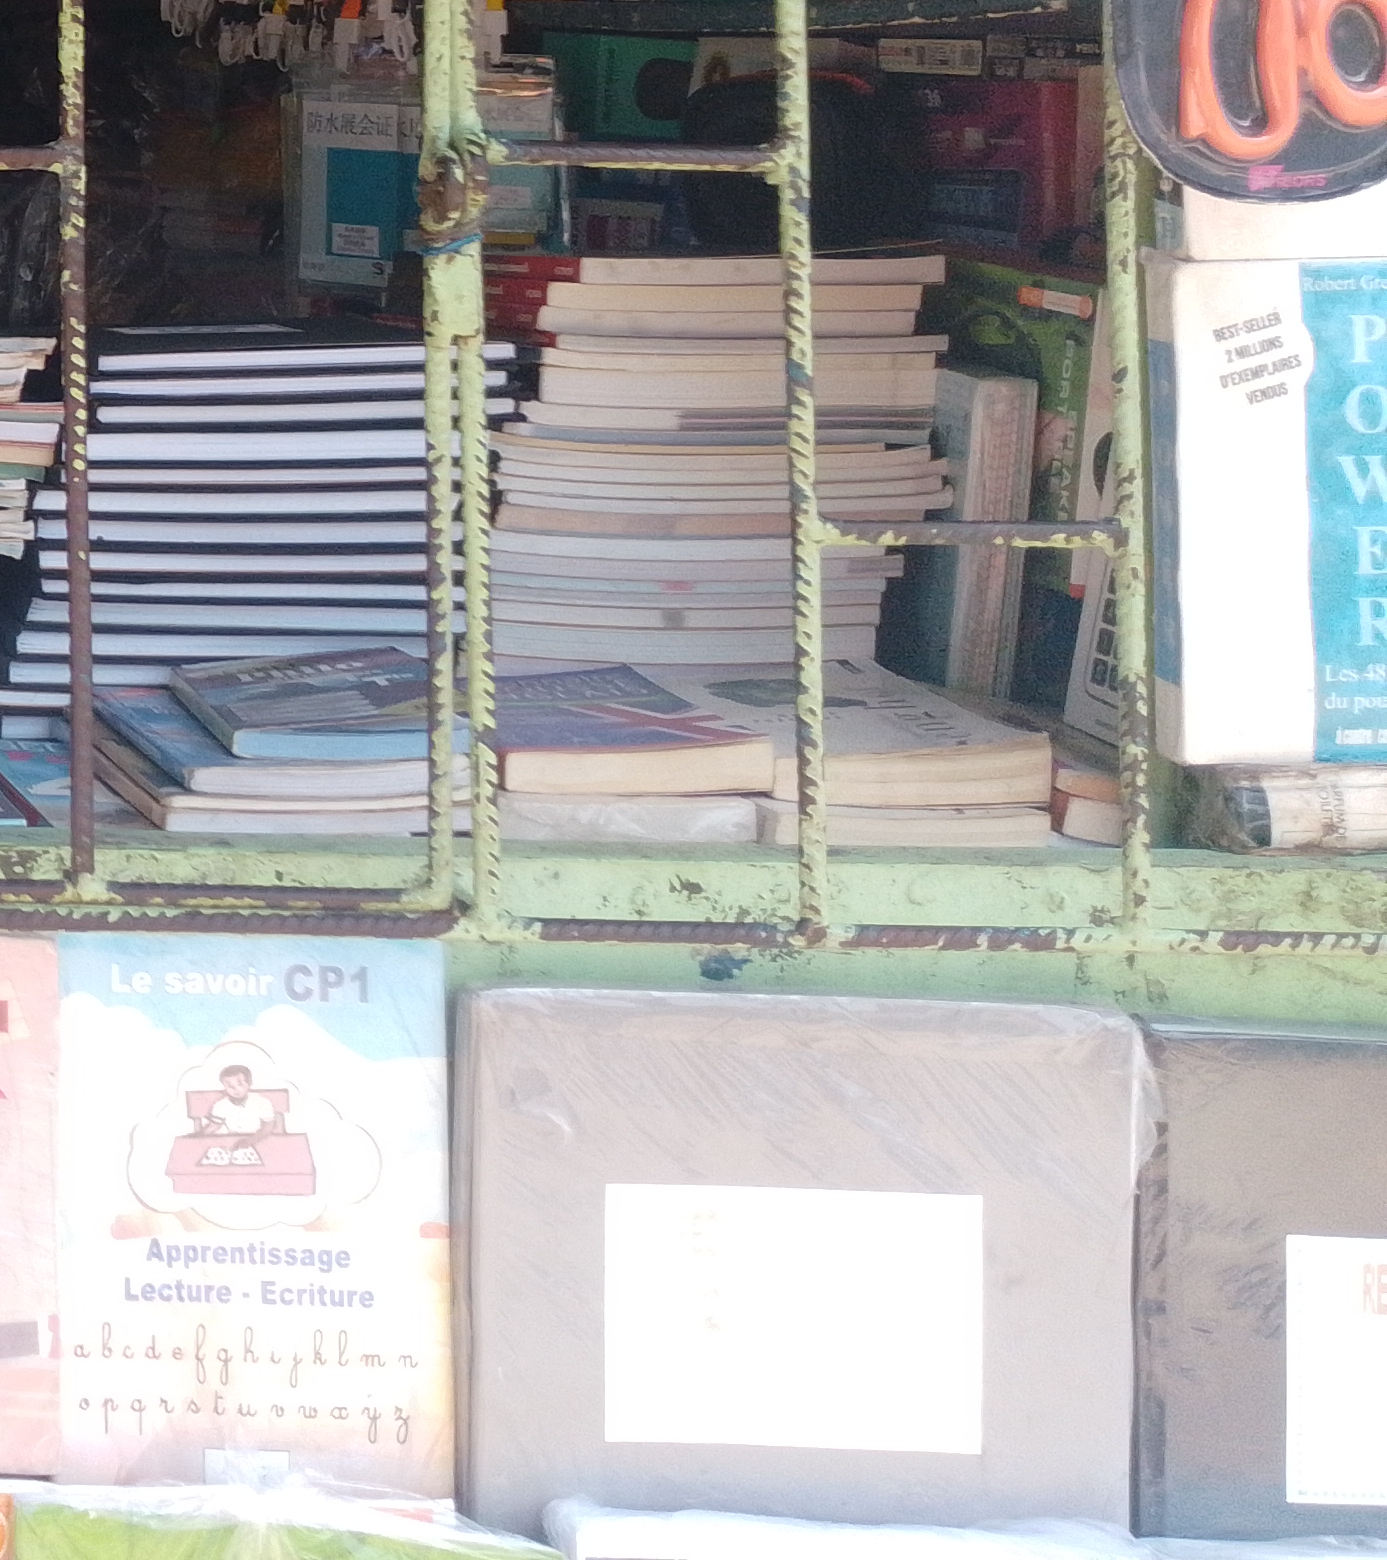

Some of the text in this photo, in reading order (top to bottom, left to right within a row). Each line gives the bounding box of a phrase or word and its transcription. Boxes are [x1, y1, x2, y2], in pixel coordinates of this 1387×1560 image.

[1302, 274, 1358, 295] Robert
[1212, 311, 1282, 343] BEST-SELLER
[1234, 334, 1286, 361] MILLIONS
[1220, 354, 1303, 390] D'EXEMPLAIRES
[1245, 379, 1290, 408] VENDUS
[1323, 662, 1358, 684] Les
[1323, 691, 1350, 712] du
[110, 963, 371, 1005] Le savoir CP1
[145, 1238, 352, 1275] Apprentissage
[124, 1276, 375, 1310] Lecture Ecriture
